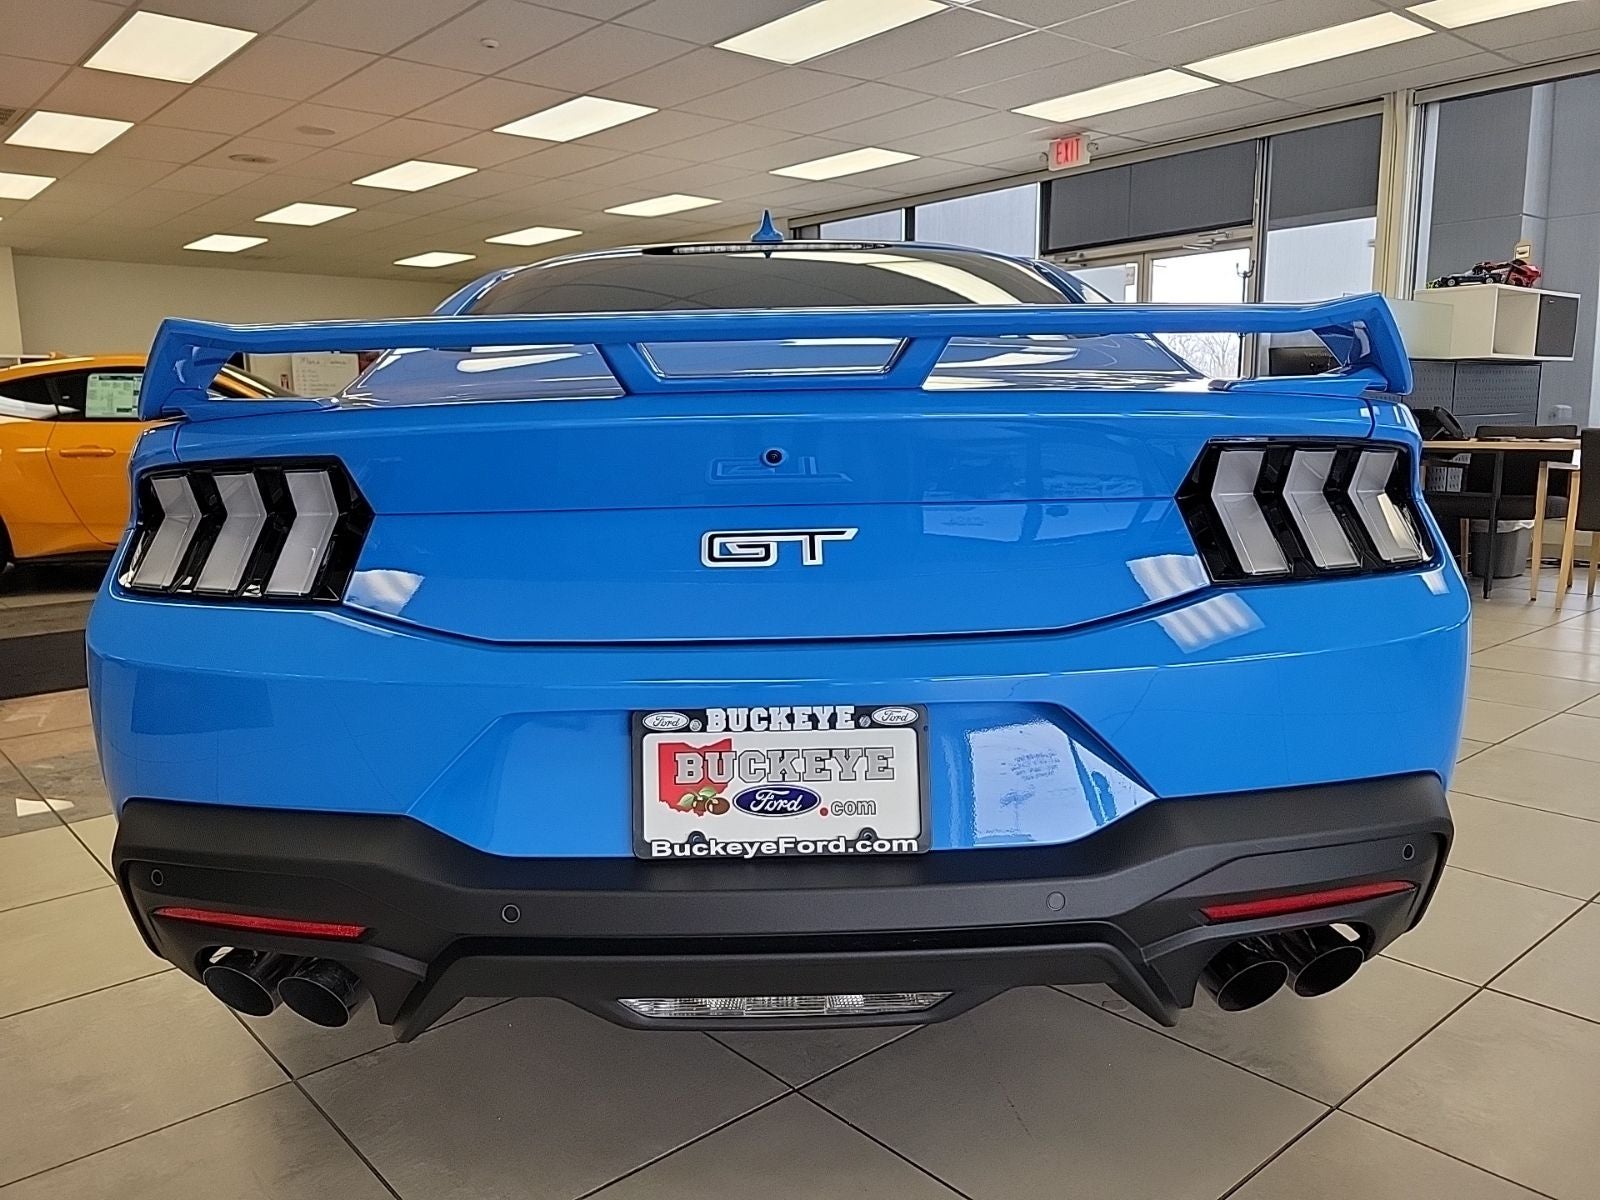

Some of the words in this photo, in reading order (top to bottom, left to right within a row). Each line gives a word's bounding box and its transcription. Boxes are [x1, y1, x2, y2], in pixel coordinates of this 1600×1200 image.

[1055, 137, 1081, 165] EXIT
[701, 527, 859, 568] GT
[706, 706, 855, 732] BUCKEYE
[674, 747, 895, 785] BUCKEYE
[750, 789, 803, 812] Ford
[651, 836, 919, 858] BuckeyeFord.com
